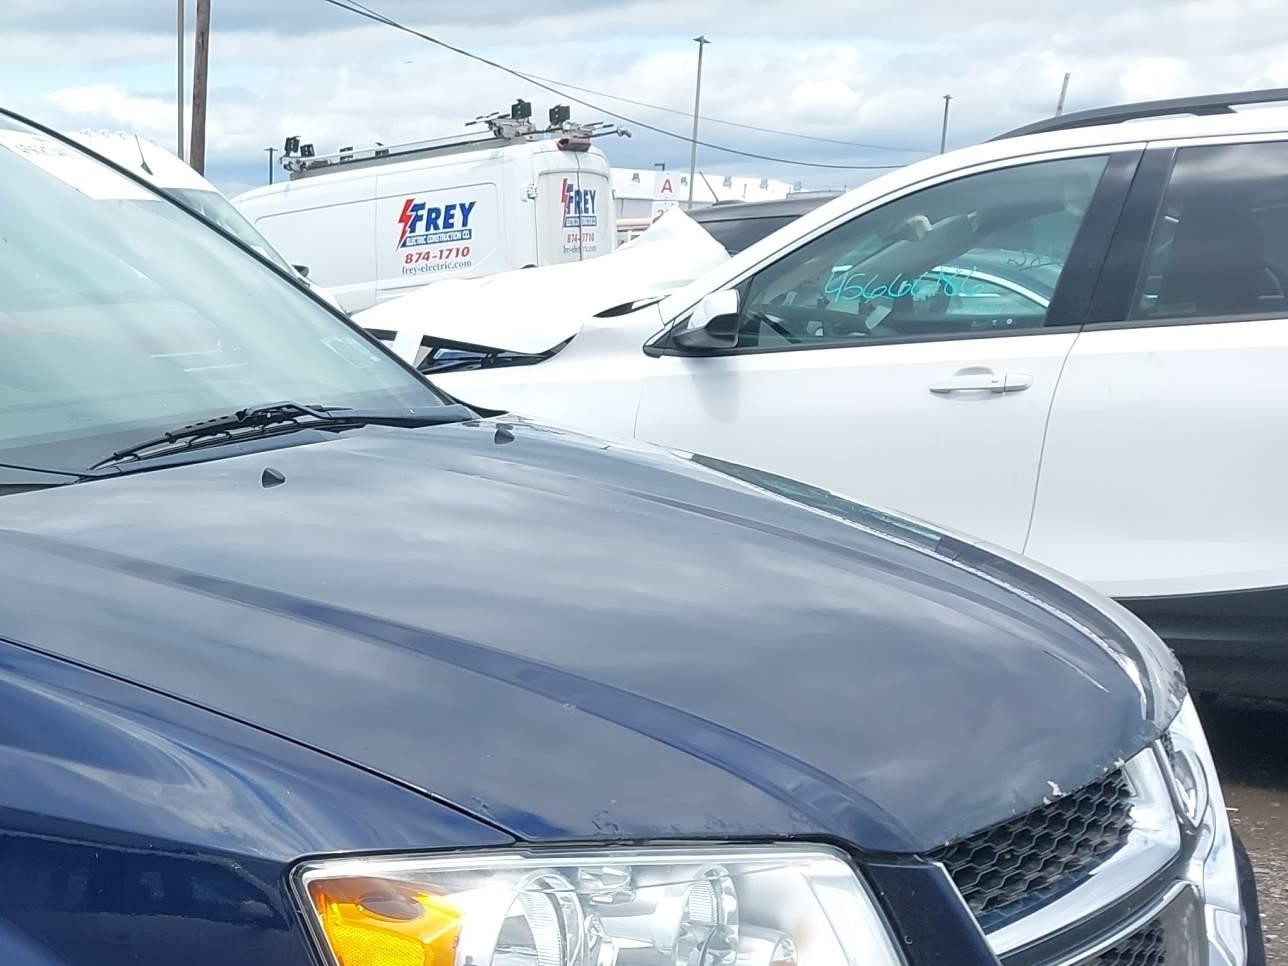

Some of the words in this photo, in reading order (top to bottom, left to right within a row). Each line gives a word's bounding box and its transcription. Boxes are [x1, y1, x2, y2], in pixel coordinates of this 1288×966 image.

[661, 179, 673, 193] A
[567, 184, 596, 214] FREY
[409, 202, 476, 233] FREY
[405, 246, 470, 264] 874-1710
[402, 261, 472, 275] frey-electric.com
